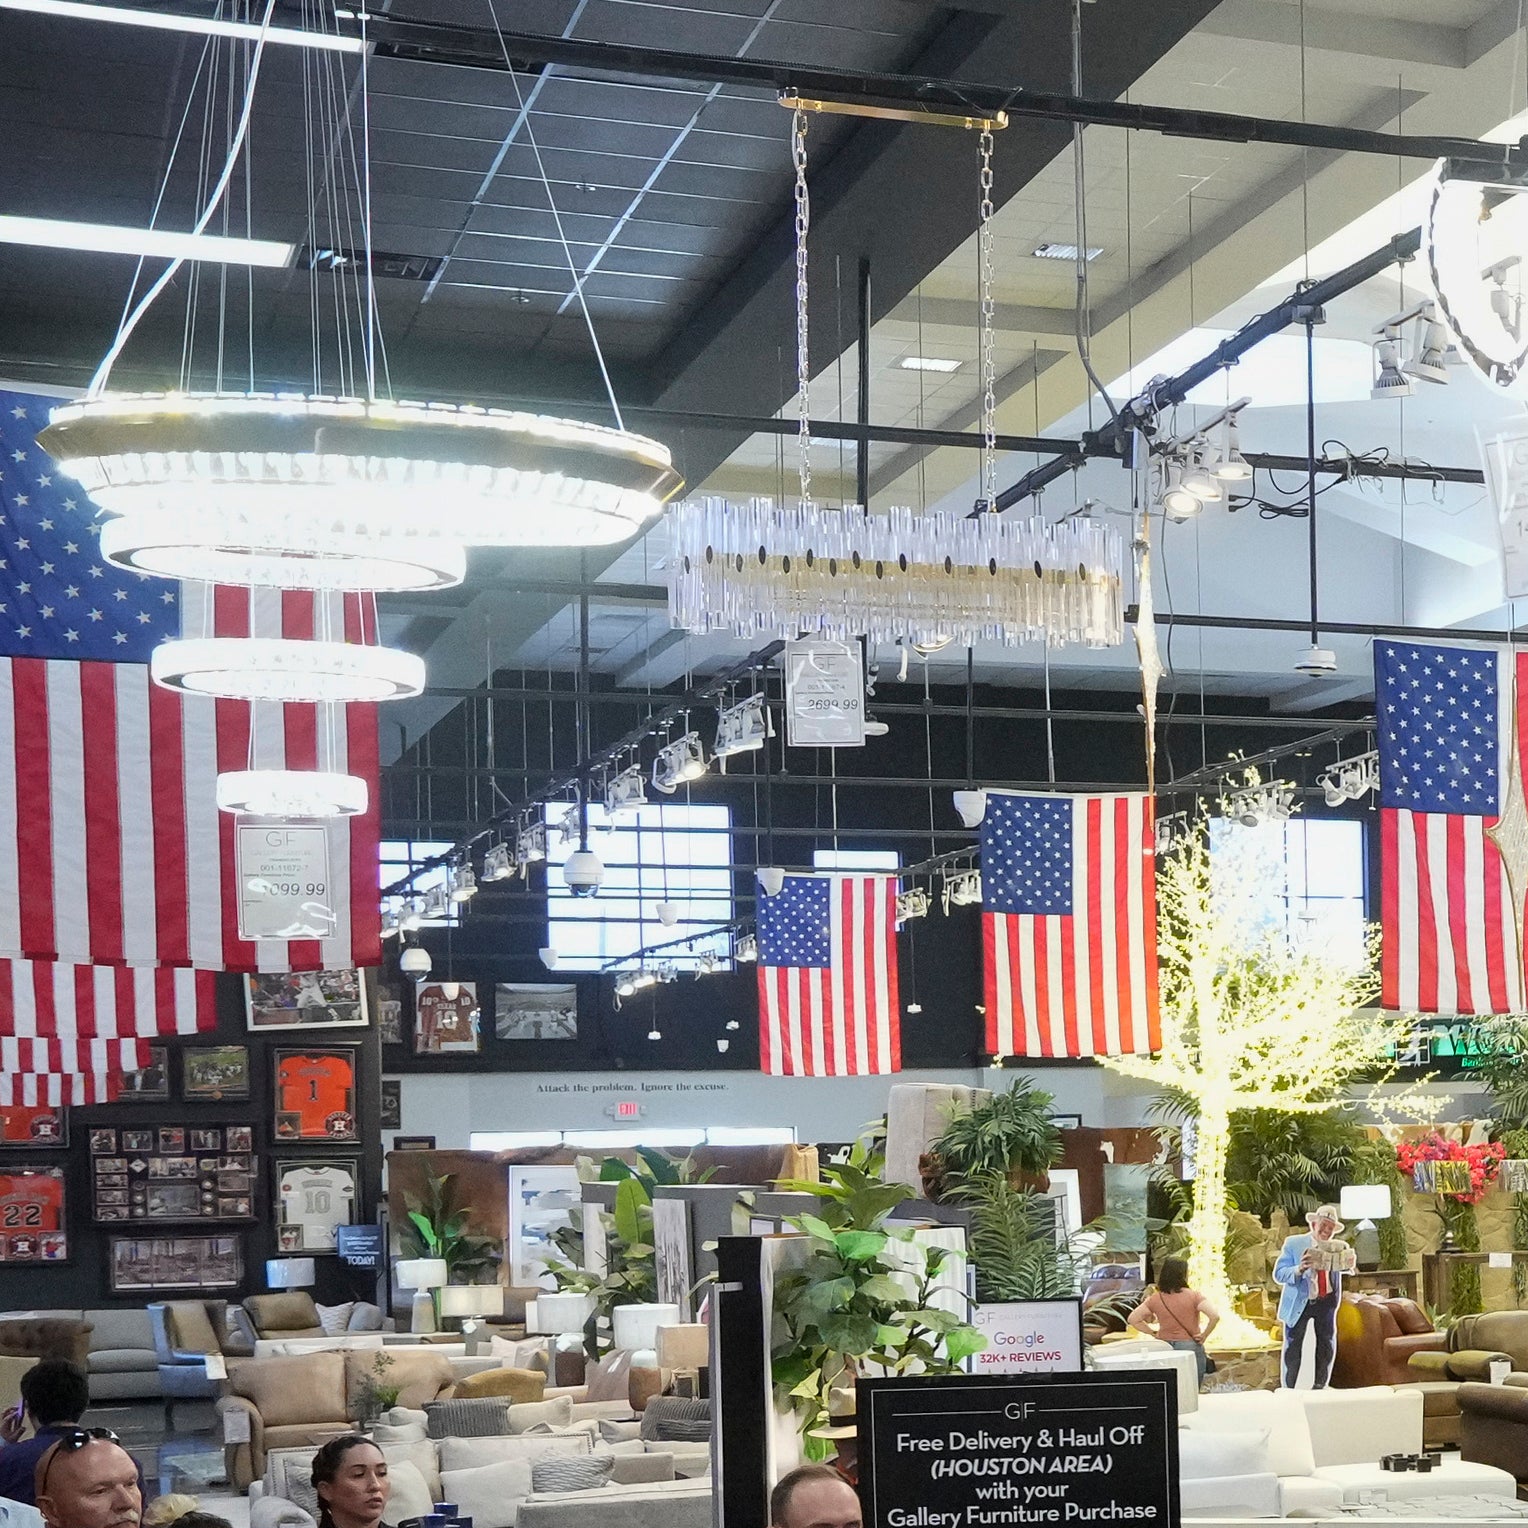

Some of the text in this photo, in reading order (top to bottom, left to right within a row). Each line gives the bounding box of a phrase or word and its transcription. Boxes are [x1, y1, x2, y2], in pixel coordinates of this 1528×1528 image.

[808, 699, 858, 710] 2699.99
[536, 1082, 729, 1094] Attack the problem. Ignore the excuse.
[4, 1204, 42, 1227] 22
[994, 1330, 1045, 1348] Google
[980, 1351, 1062, 1363] 32K+ REVIEWS
[896, 1425, 1145, 1453] Free Delivery & Haul Off
[930, 1454, 1113, 1480] (HOUSTON AREA)
[975, 1479, 1069, 1503] with your
[966, 1505, 1060, 1524] Furniture
[1065, 1500, 1157, 1521] Purchase
